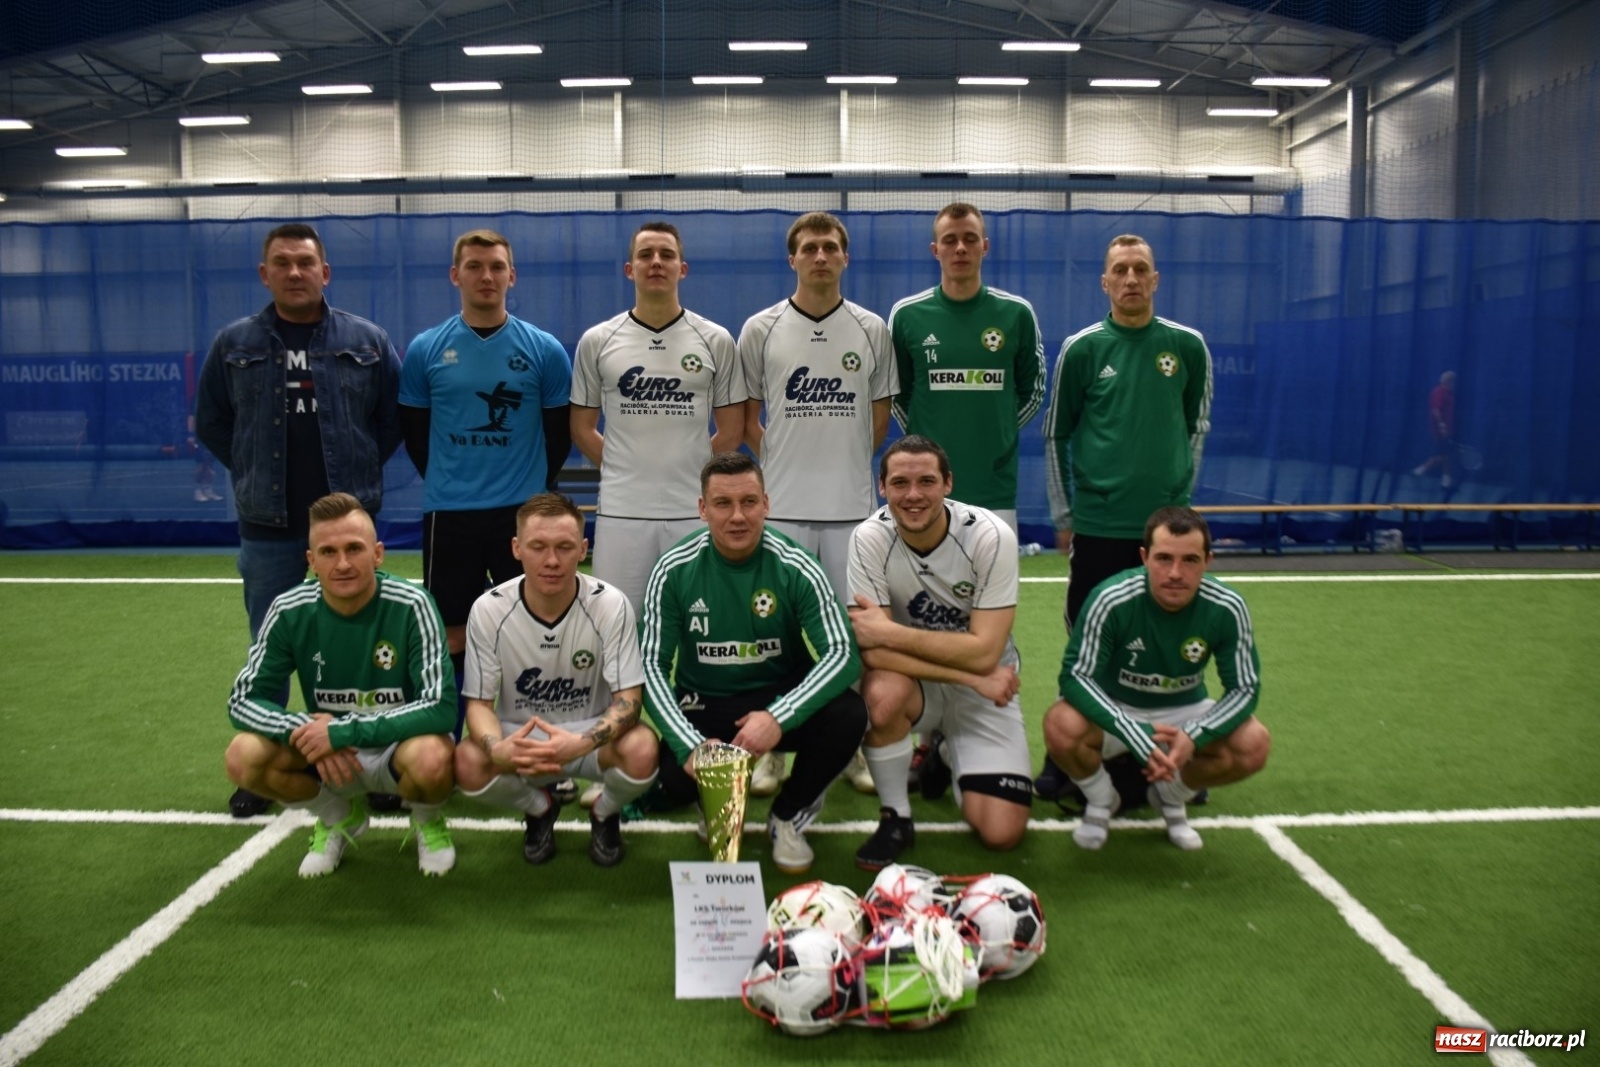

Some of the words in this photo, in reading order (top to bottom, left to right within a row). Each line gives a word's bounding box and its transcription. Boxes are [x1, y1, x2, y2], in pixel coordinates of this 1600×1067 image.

[287, 350, 311, 370] M
[924, 349, 938, 363] 14
[2, 361, 103, 383] MAUGLÍHO
[109, 363, 181, 382] STEZKA
[930, 370, 1003, 384] KERAKOLL
[631, 390, 695, 402] KANTOR
[796, 392, 856, 403] KANTOR
[785, 411, 823, 419] (GALERIA
[449, 433, 467, 445] Va
[689, 615, 710, 637] AJ
[316, 691, 403, 707] KERAKOLL
[528, 686, 591, 701] KANTOR
[706, 874, 755, 885] DYPLOM
